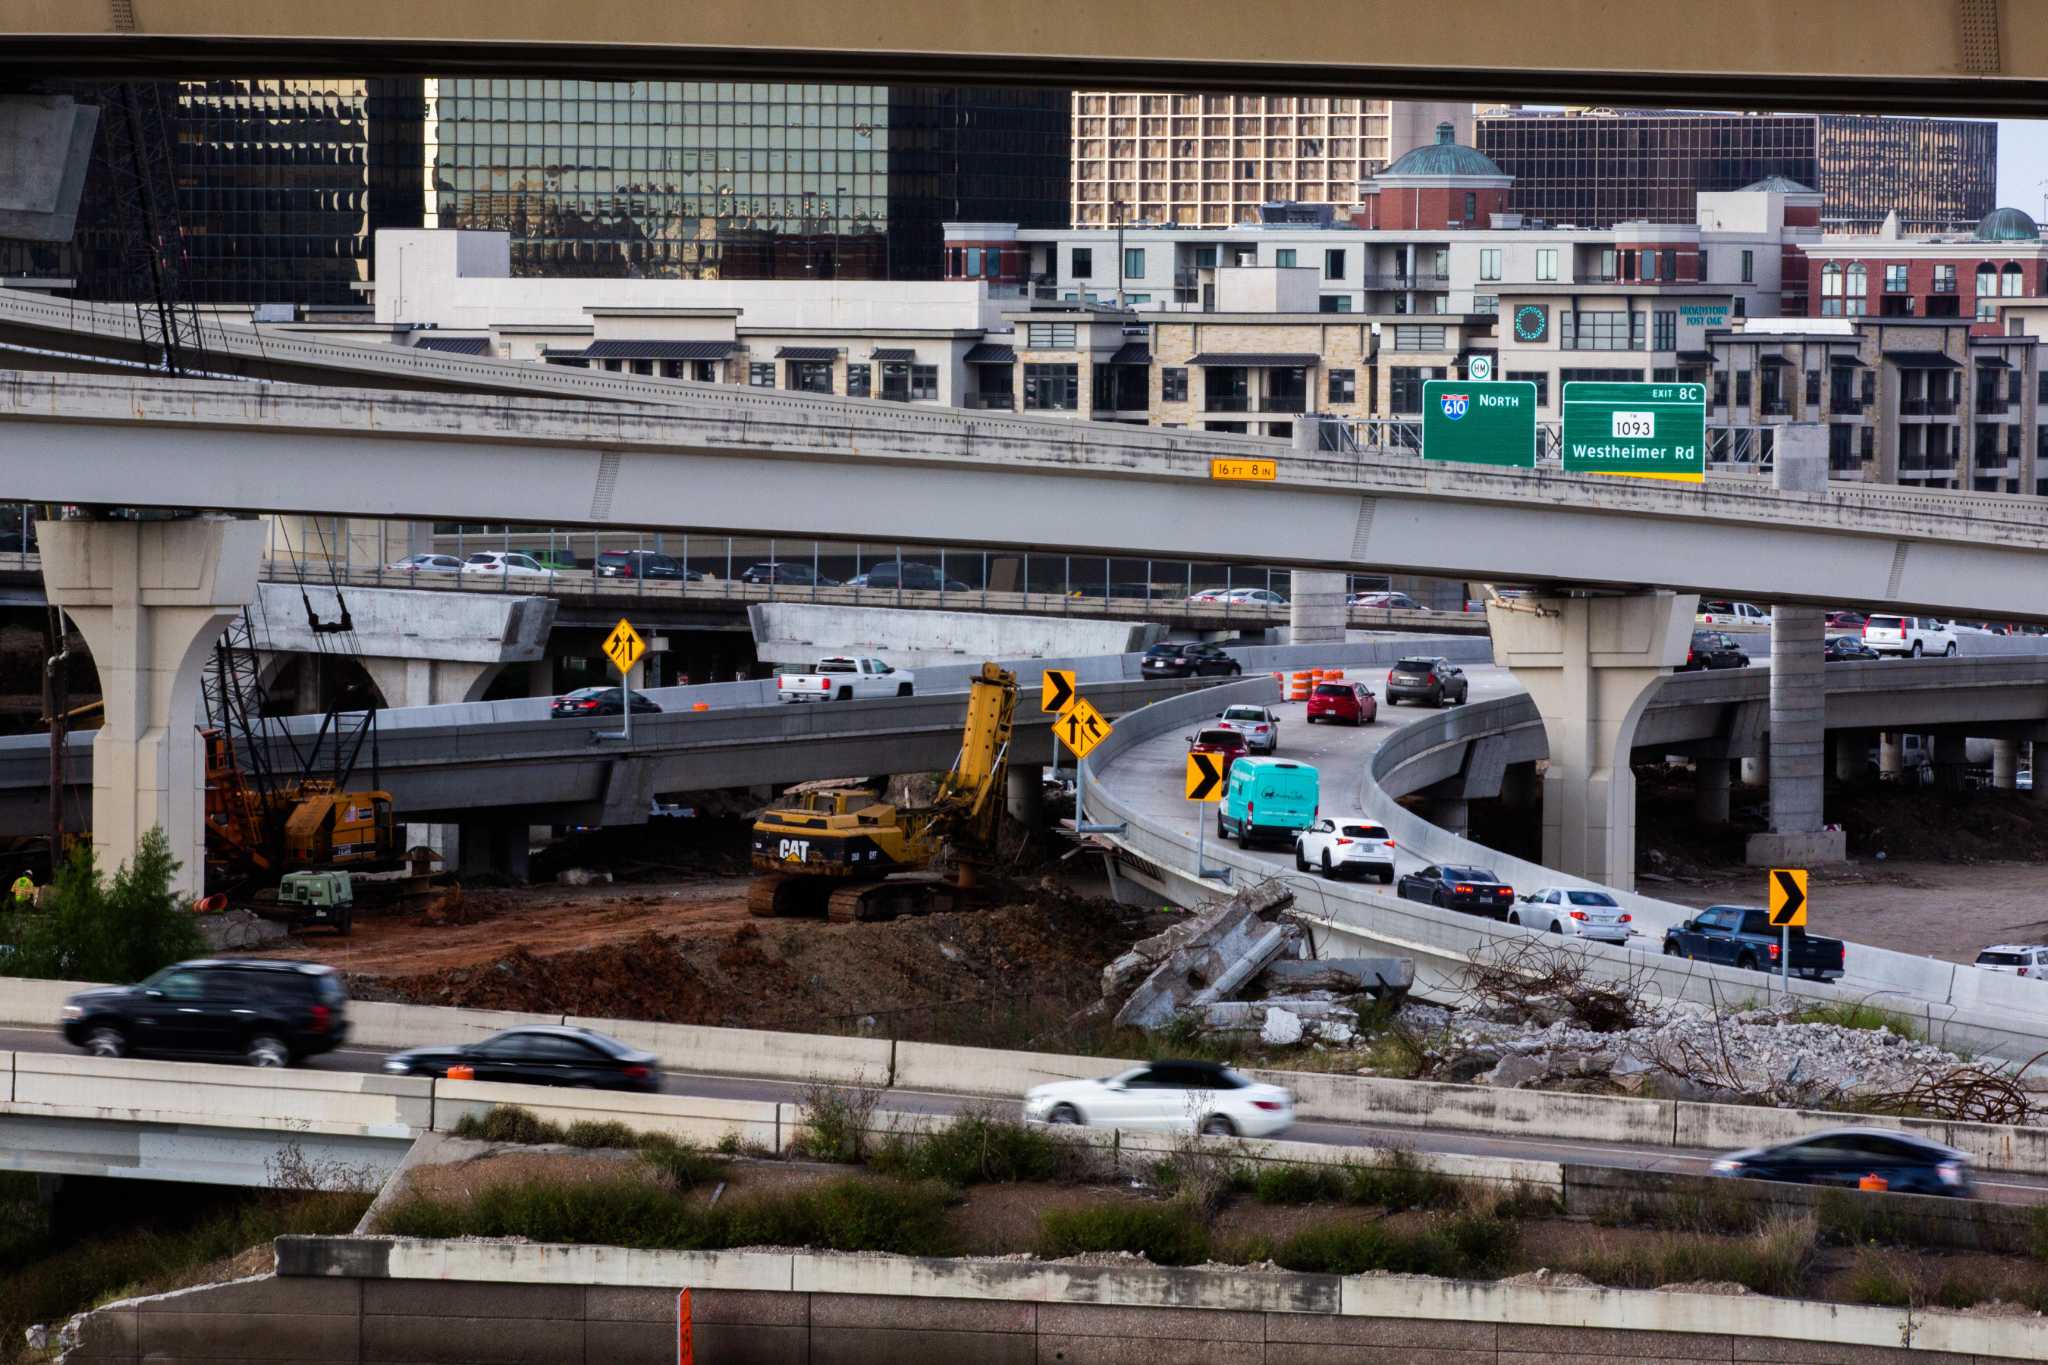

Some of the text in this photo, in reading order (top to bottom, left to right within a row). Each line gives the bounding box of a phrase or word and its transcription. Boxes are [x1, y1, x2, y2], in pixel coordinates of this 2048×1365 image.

[1687, 317, 1723, 326] POST OAK
[1474, 364, 1486, 373] HM
[1480, 394, 1519, 407] NORTH
[1652, 388, 1697, 400] EXIT 8C
[1444, 401, 1466, 415] 610
[1616, 422, 1650, 435] 1093
[1573, 444, 1694, 459] Westheimer Rd
[1219, 464, 1229, 475] 16
[1232, 467, 1242, 475] FT
[1252, 464, 1258, 475] 8
[780, 839, 809, 863] CAT
